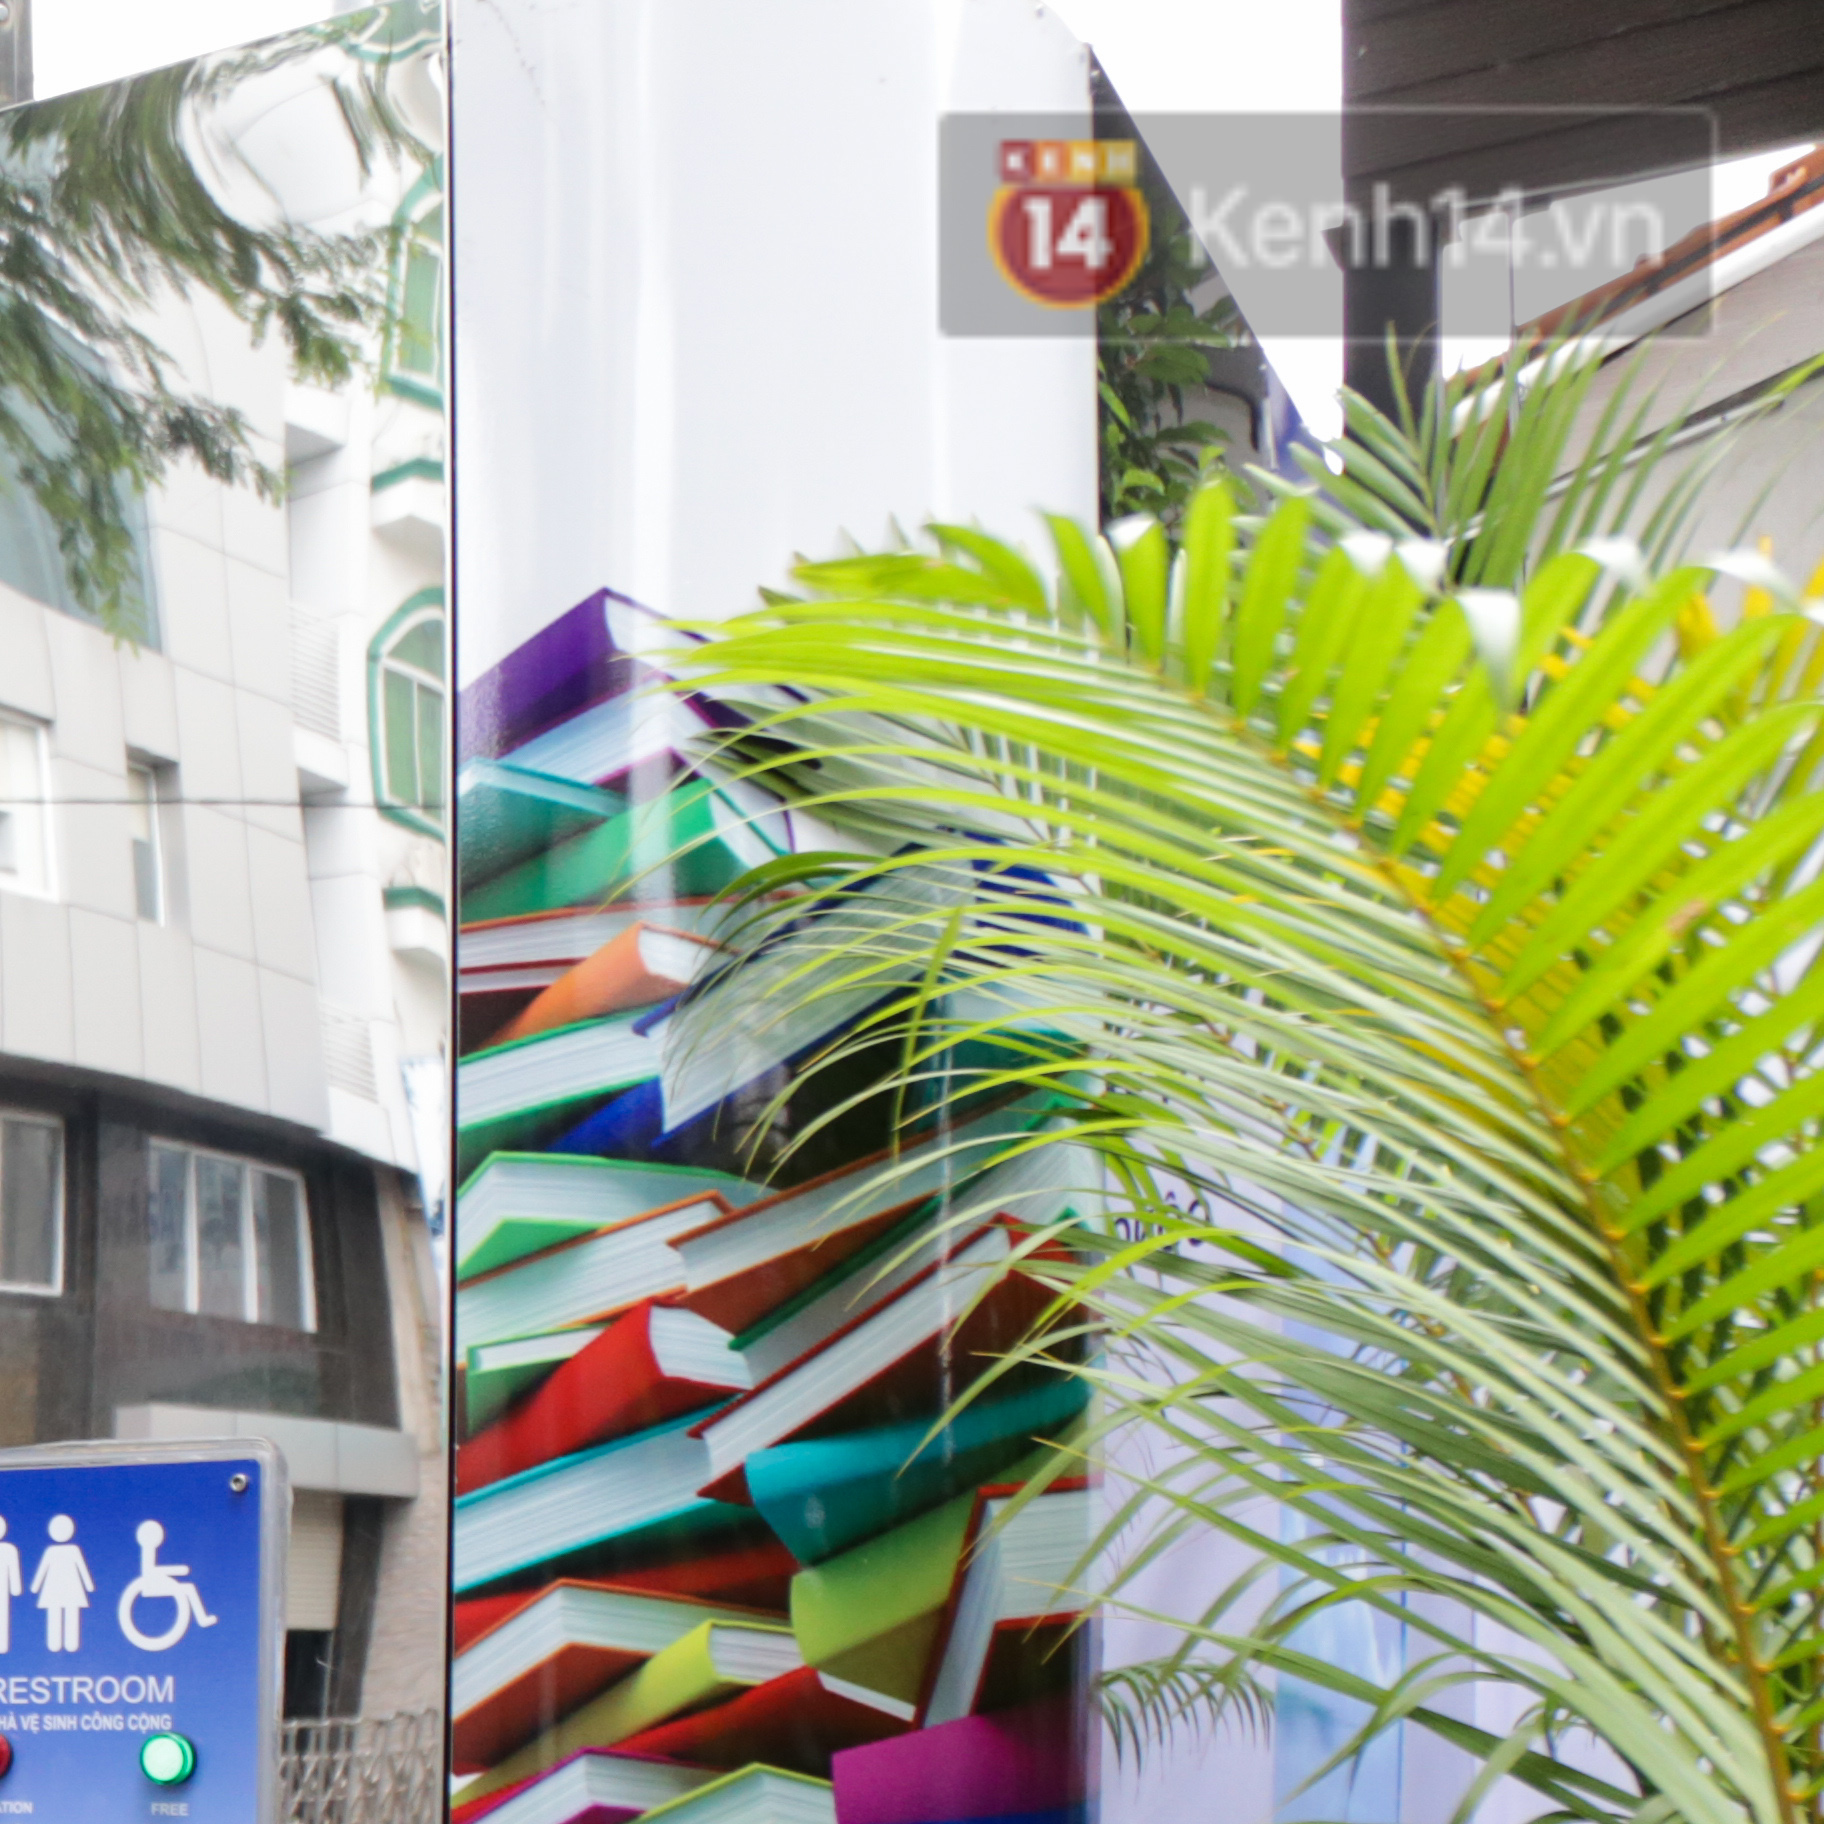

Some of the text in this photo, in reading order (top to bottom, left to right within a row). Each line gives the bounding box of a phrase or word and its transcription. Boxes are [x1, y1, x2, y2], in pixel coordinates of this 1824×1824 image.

[21, 1712, 40, 1734] VỆ
[43, 1714, 77, 1731] SINH
[81, 1711, 124, 1731] CÔNG
[128, 1711, 173, 1734] CỘNG
[151, 1802, 190, 1816] FREE
